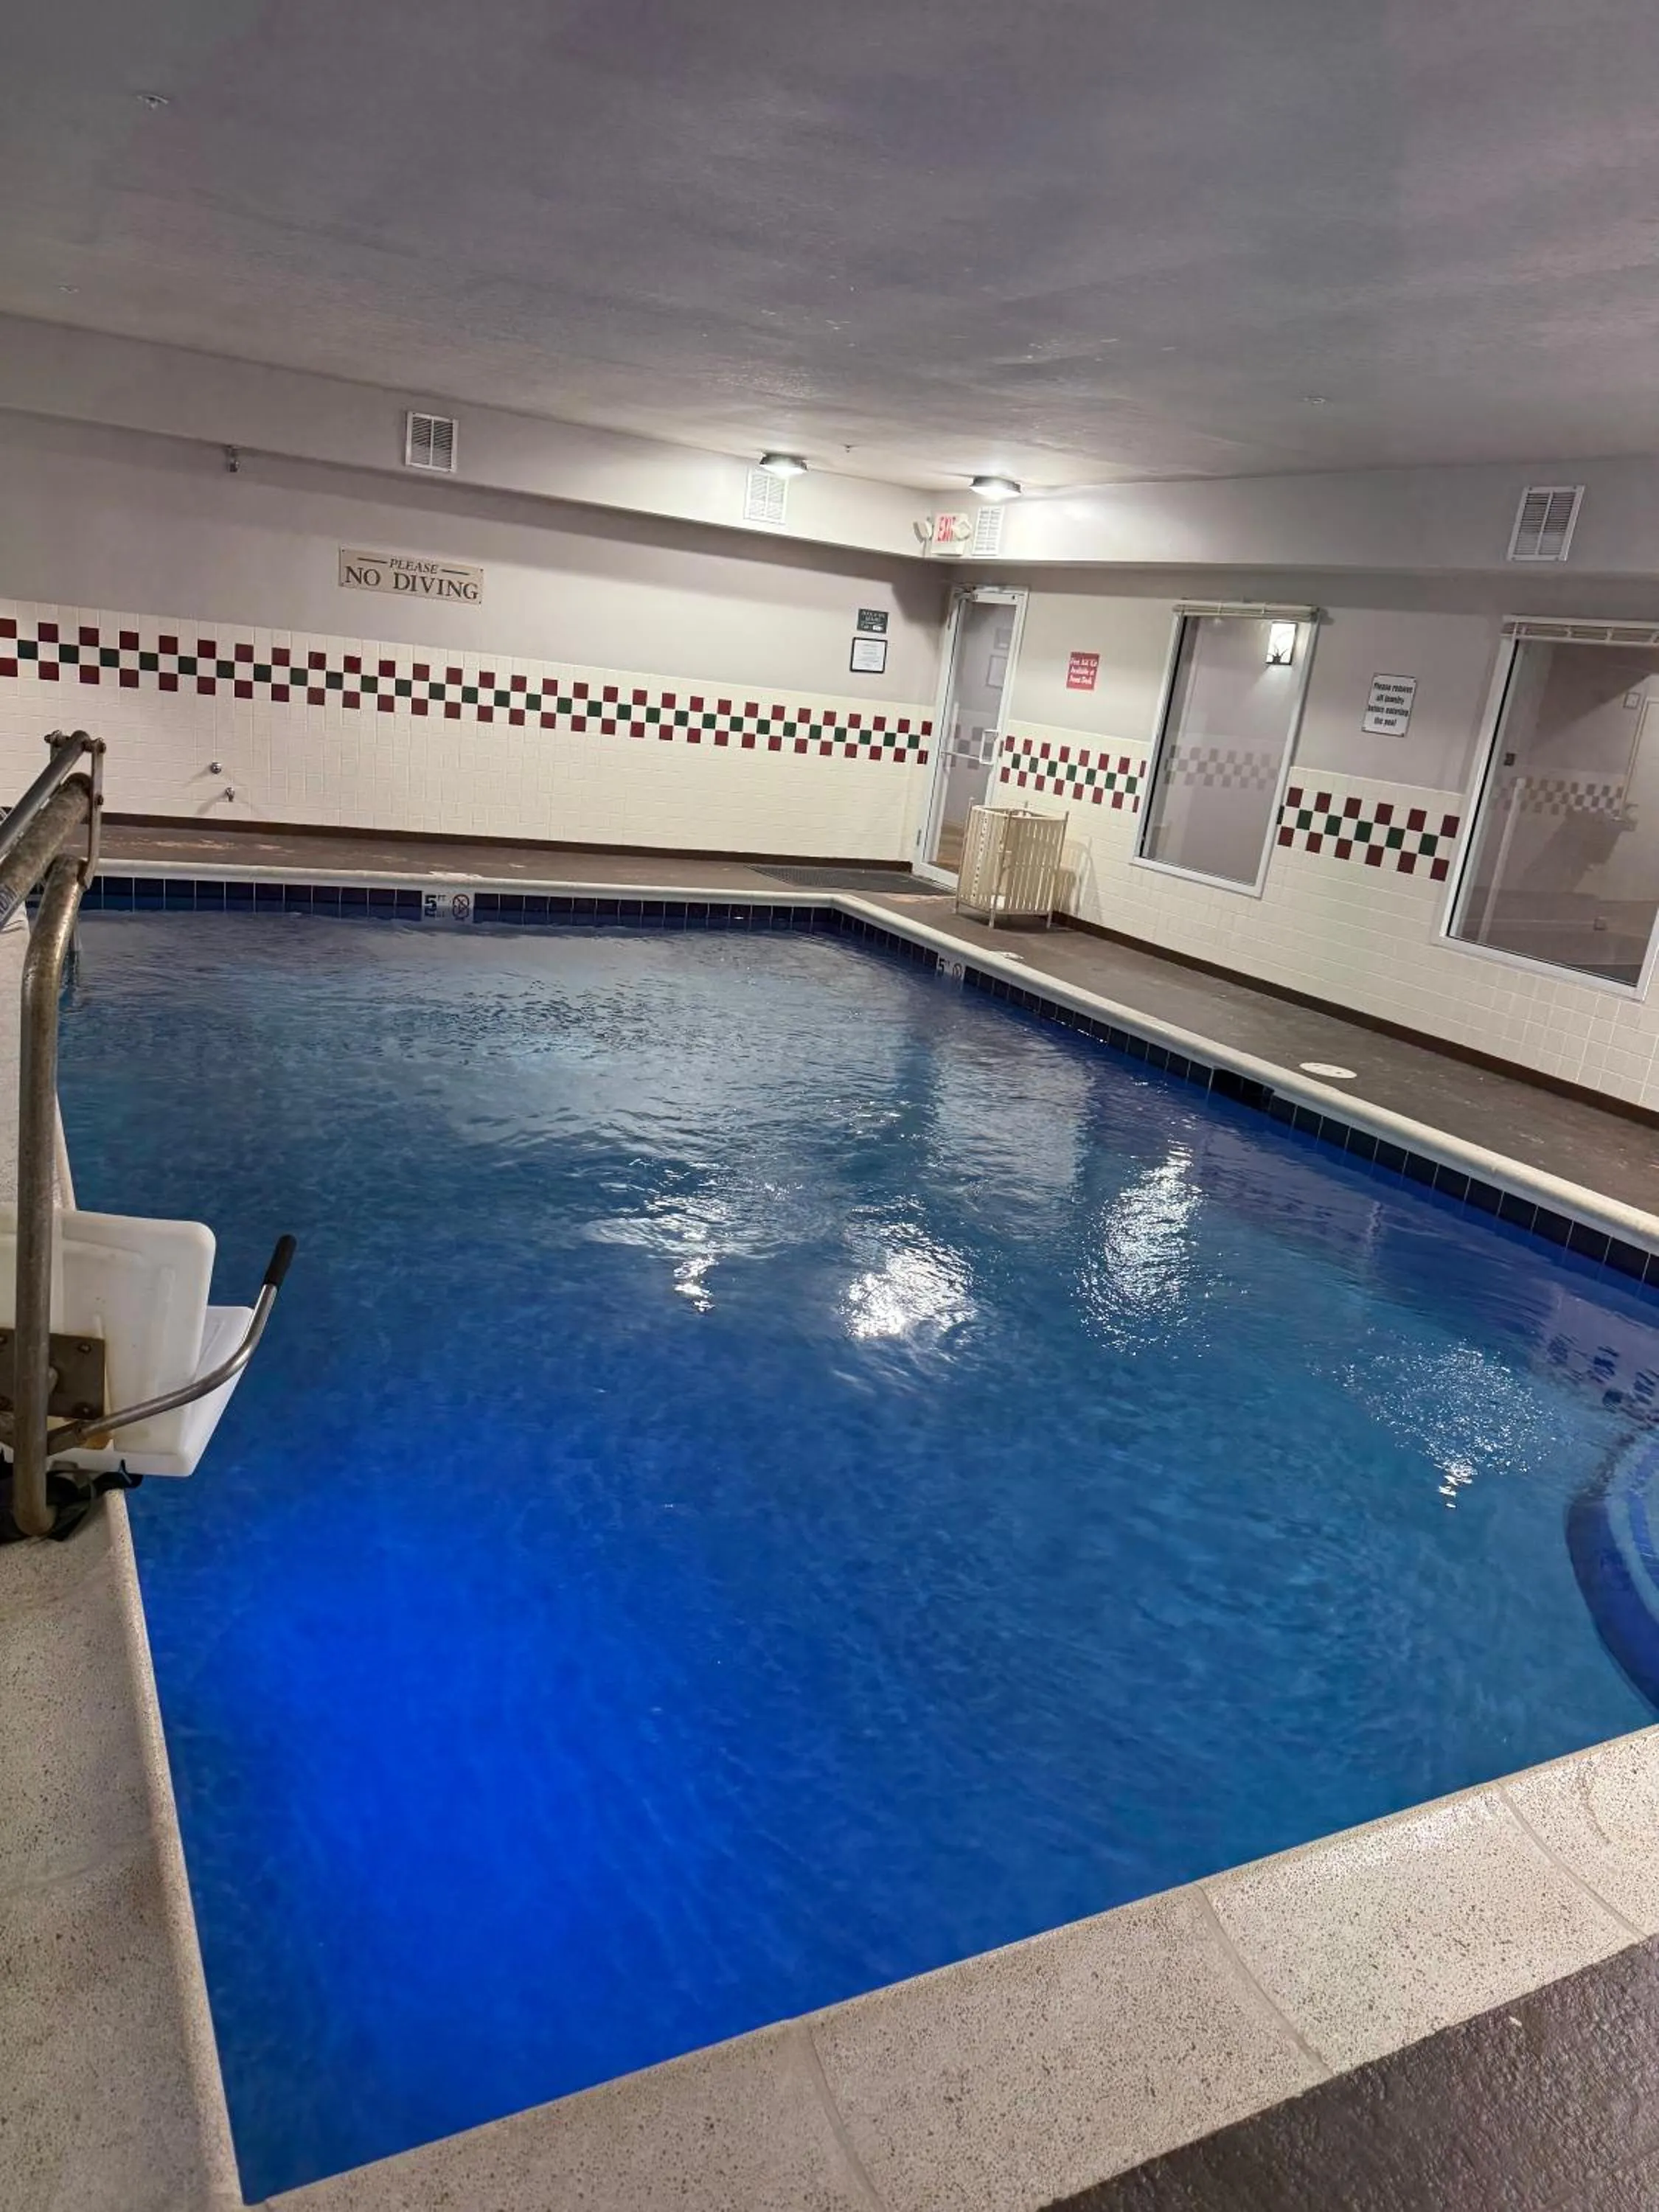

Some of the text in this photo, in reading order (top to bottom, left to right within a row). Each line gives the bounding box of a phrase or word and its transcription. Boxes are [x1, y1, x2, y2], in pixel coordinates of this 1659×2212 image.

[389, 558, 439, 574] PLEASE
[345, 566, 479, 599] NO DIVING
[424, 894, 437, 917] 5
